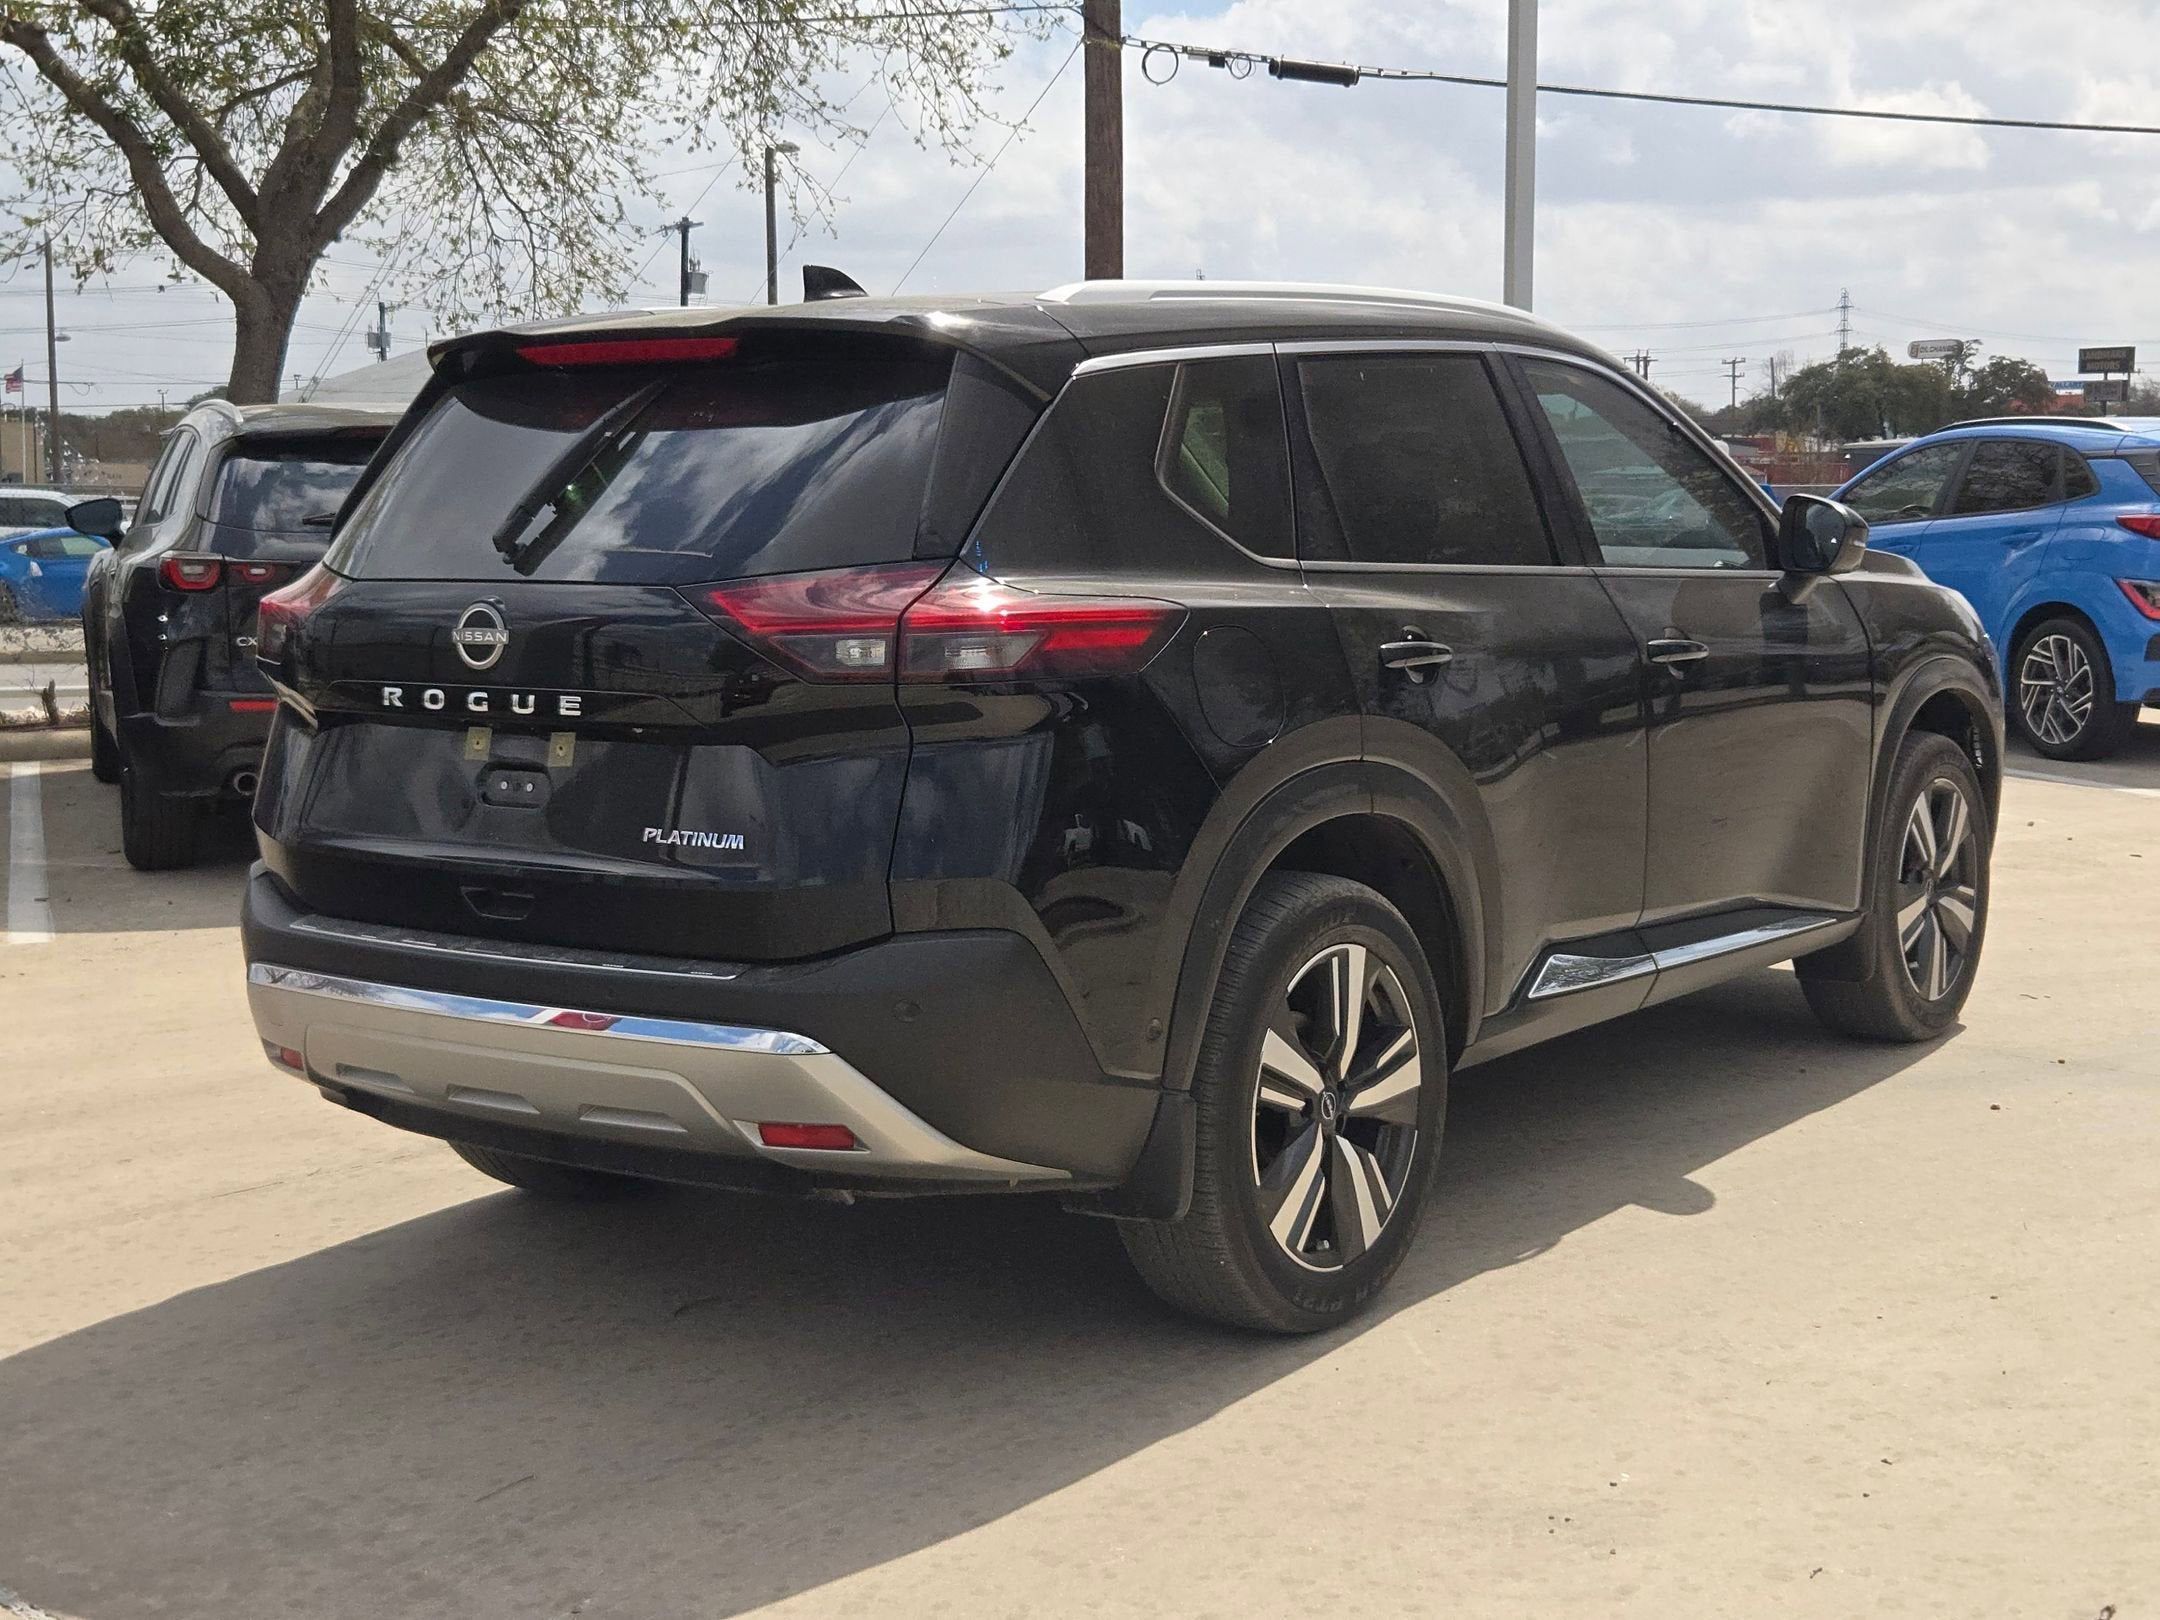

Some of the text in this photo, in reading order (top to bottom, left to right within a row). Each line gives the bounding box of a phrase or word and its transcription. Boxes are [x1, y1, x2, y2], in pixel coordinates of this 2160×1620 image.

[452, 630, 507, 642] NISSAN
[382, 686, 582, 716] ROGUE
[642, 827, 744, 849] PLATINUM
